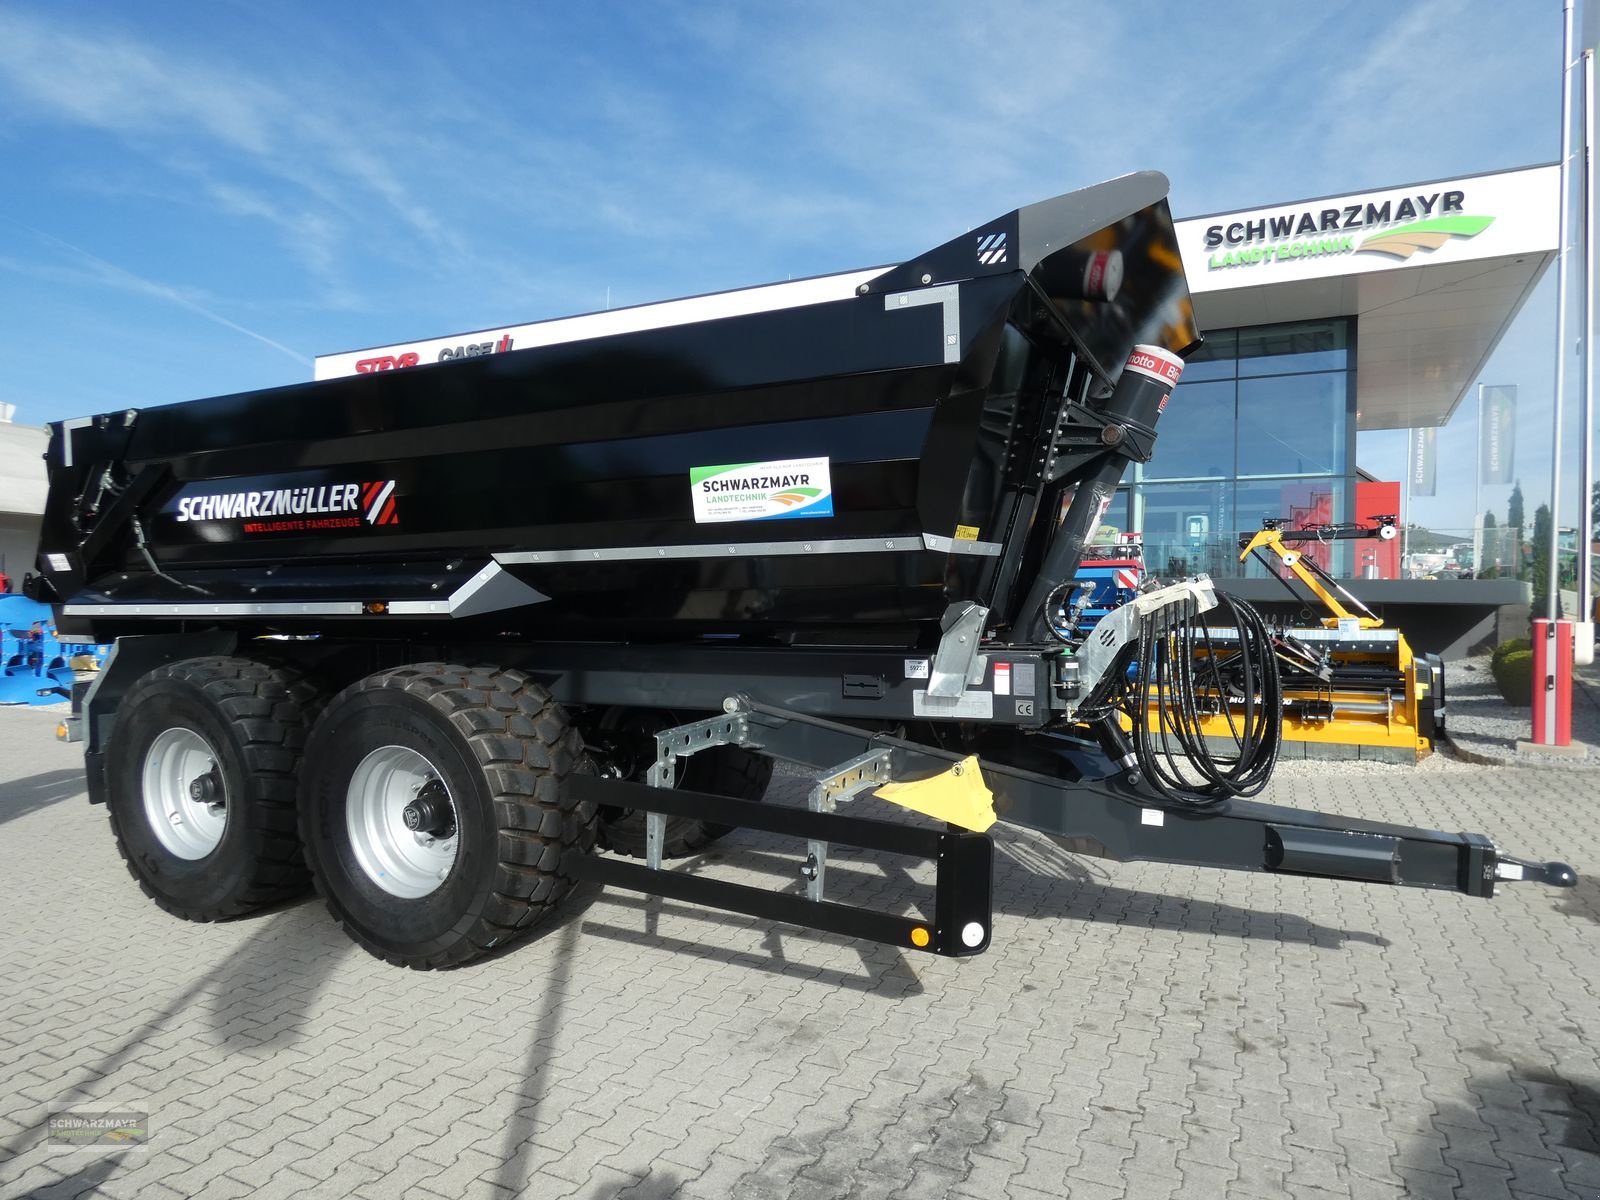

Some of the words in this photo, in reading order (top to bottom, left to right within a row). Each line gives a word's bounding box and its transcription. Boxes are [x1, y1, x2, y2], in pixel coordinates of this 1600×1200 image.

[1205, 190, 1465, 247] SCHWARZMAYR
[1208, 234, 1355, 270] LANDTECHNIK
[438, 341, 493, 362] CASE
[703, 474, 810, 493] SCHWARZMAYR
[706, 492, 767, 504] LANDTECHNIK
[244, 522, 304, 533] INTELLIGENTE
[306, 517, 361, 529] FAHRZEUGE
